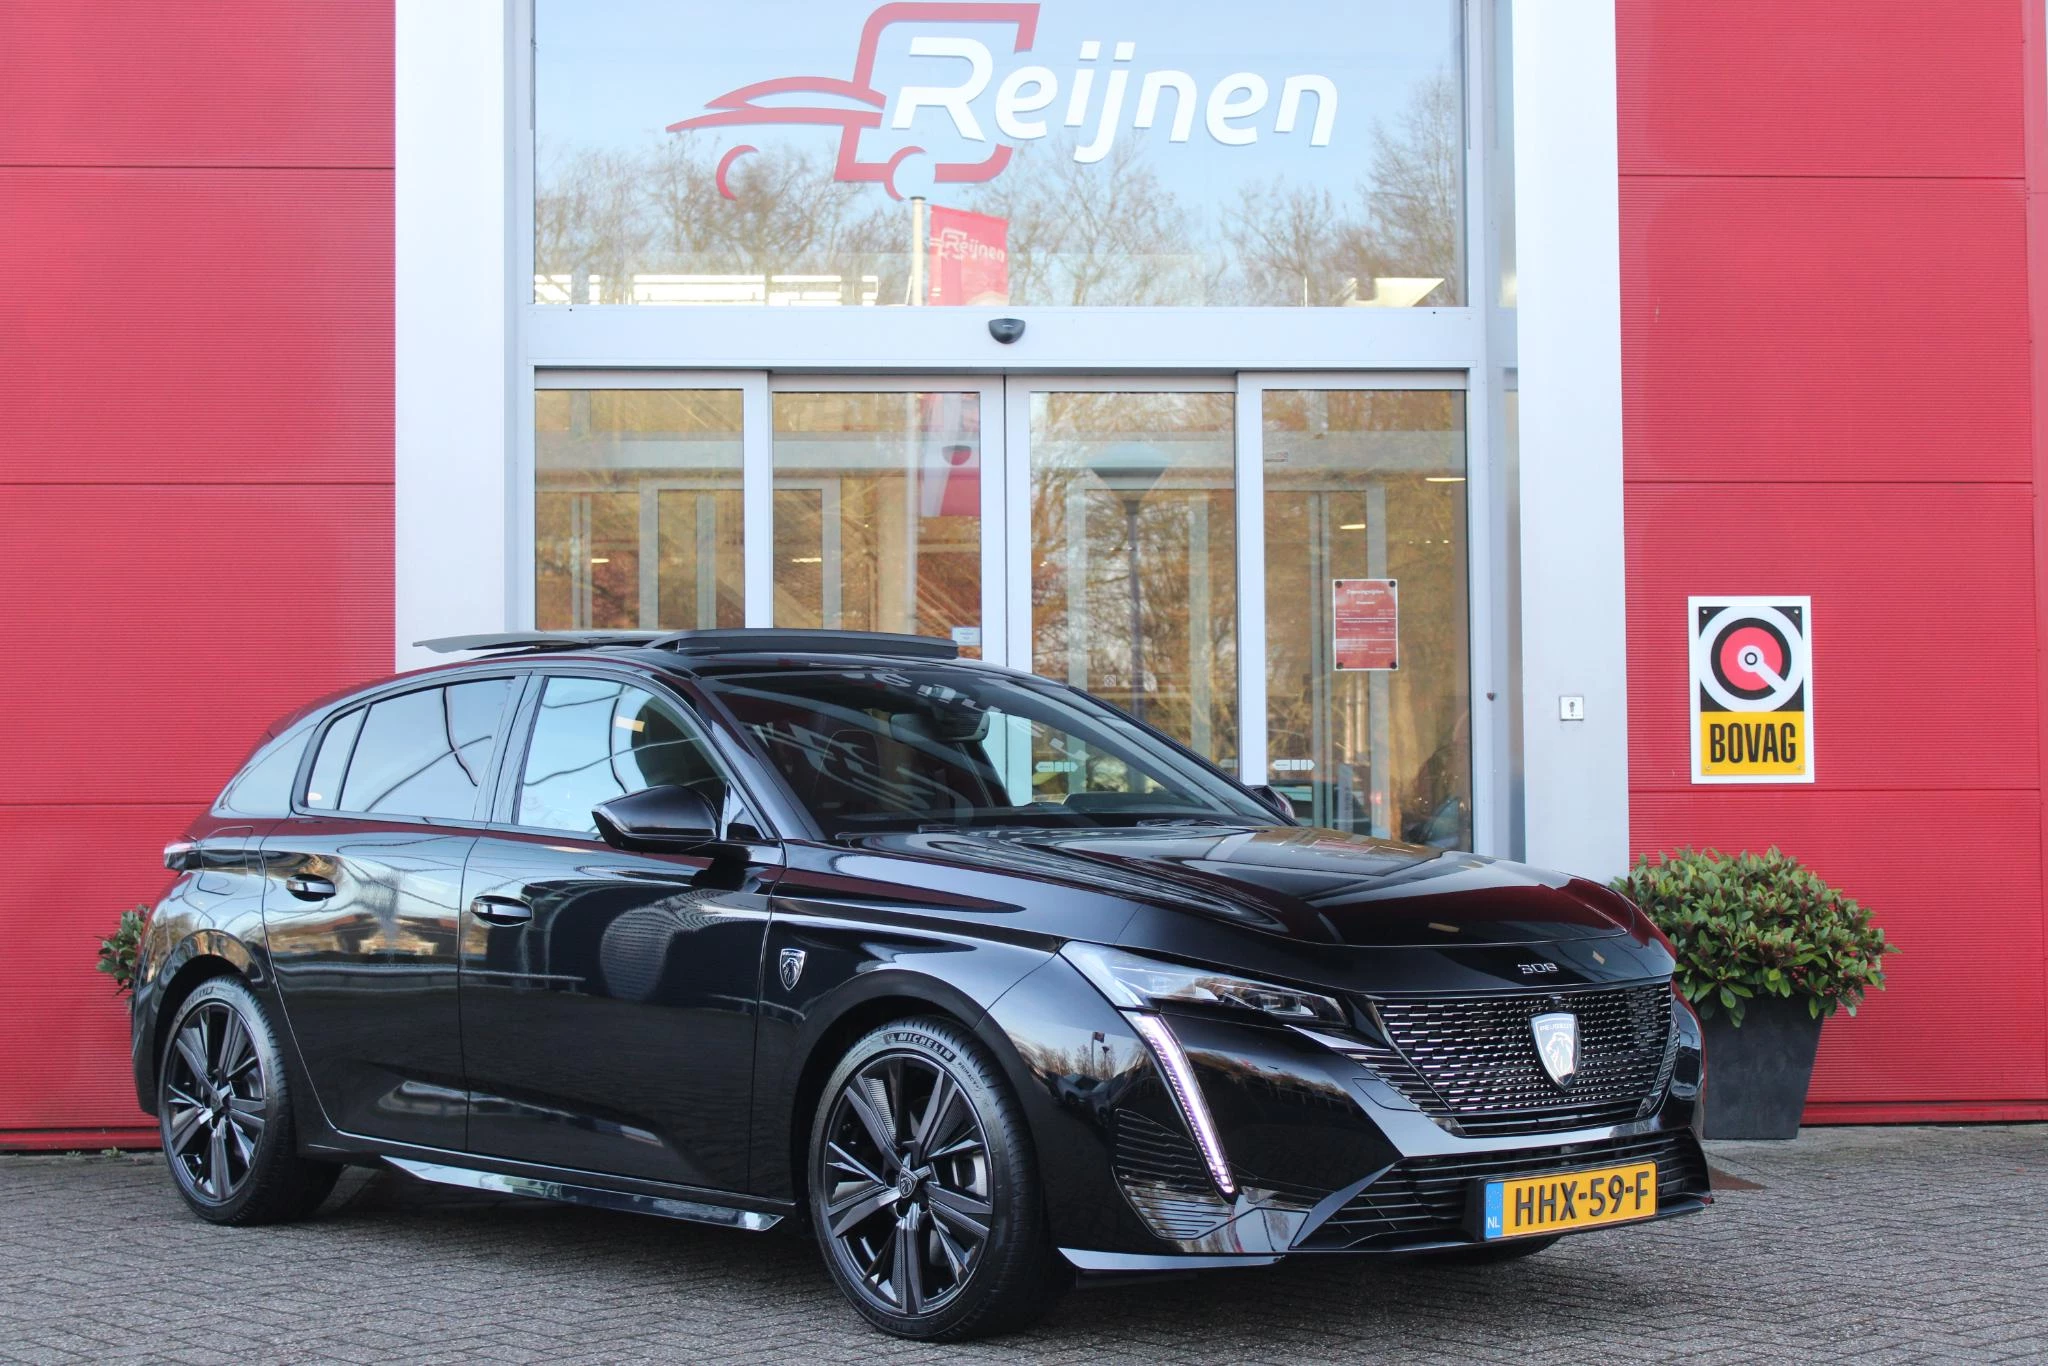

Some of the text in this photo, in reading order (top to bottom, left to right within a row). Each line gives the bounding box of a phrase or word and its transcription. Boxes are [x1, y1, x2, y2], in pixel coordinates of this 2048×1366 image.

[891, 36, 1338, 164] Reijnen
[1710, 722, 1796, 764] BOVAG
[1517, 962, 1559, 975] 308
[897, 1032, 954, 1061] MICHELIN
[1515, 1171, 1649, 1226] HHX-59-F
[1487, 1217, 1500, 1228] NL
